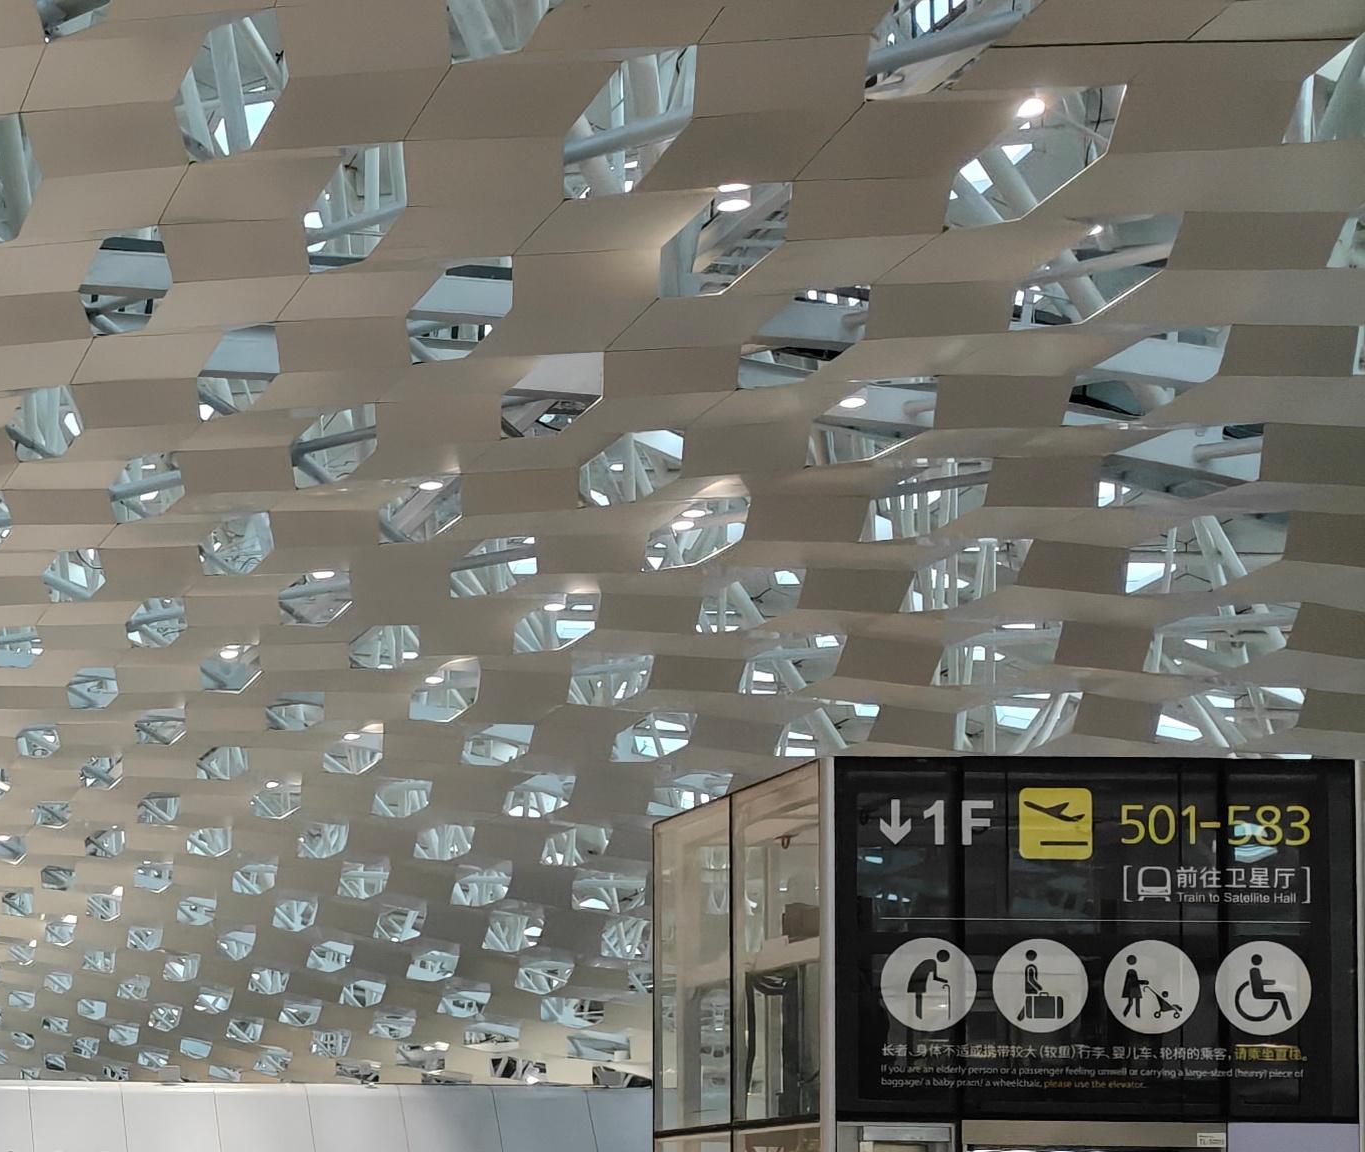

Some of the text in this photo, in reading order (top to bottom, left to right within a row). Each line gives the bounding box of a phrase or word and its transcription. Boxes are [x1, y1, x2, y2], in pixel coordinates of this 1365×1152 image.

[924, 800, 994, 845] 1F
[1121, 804, 1311, 846] 501-583
[1175, 866, 1296, 889] 前往卫星厅
[1178, 892, 1297, 904] Train to Satellite Hall
